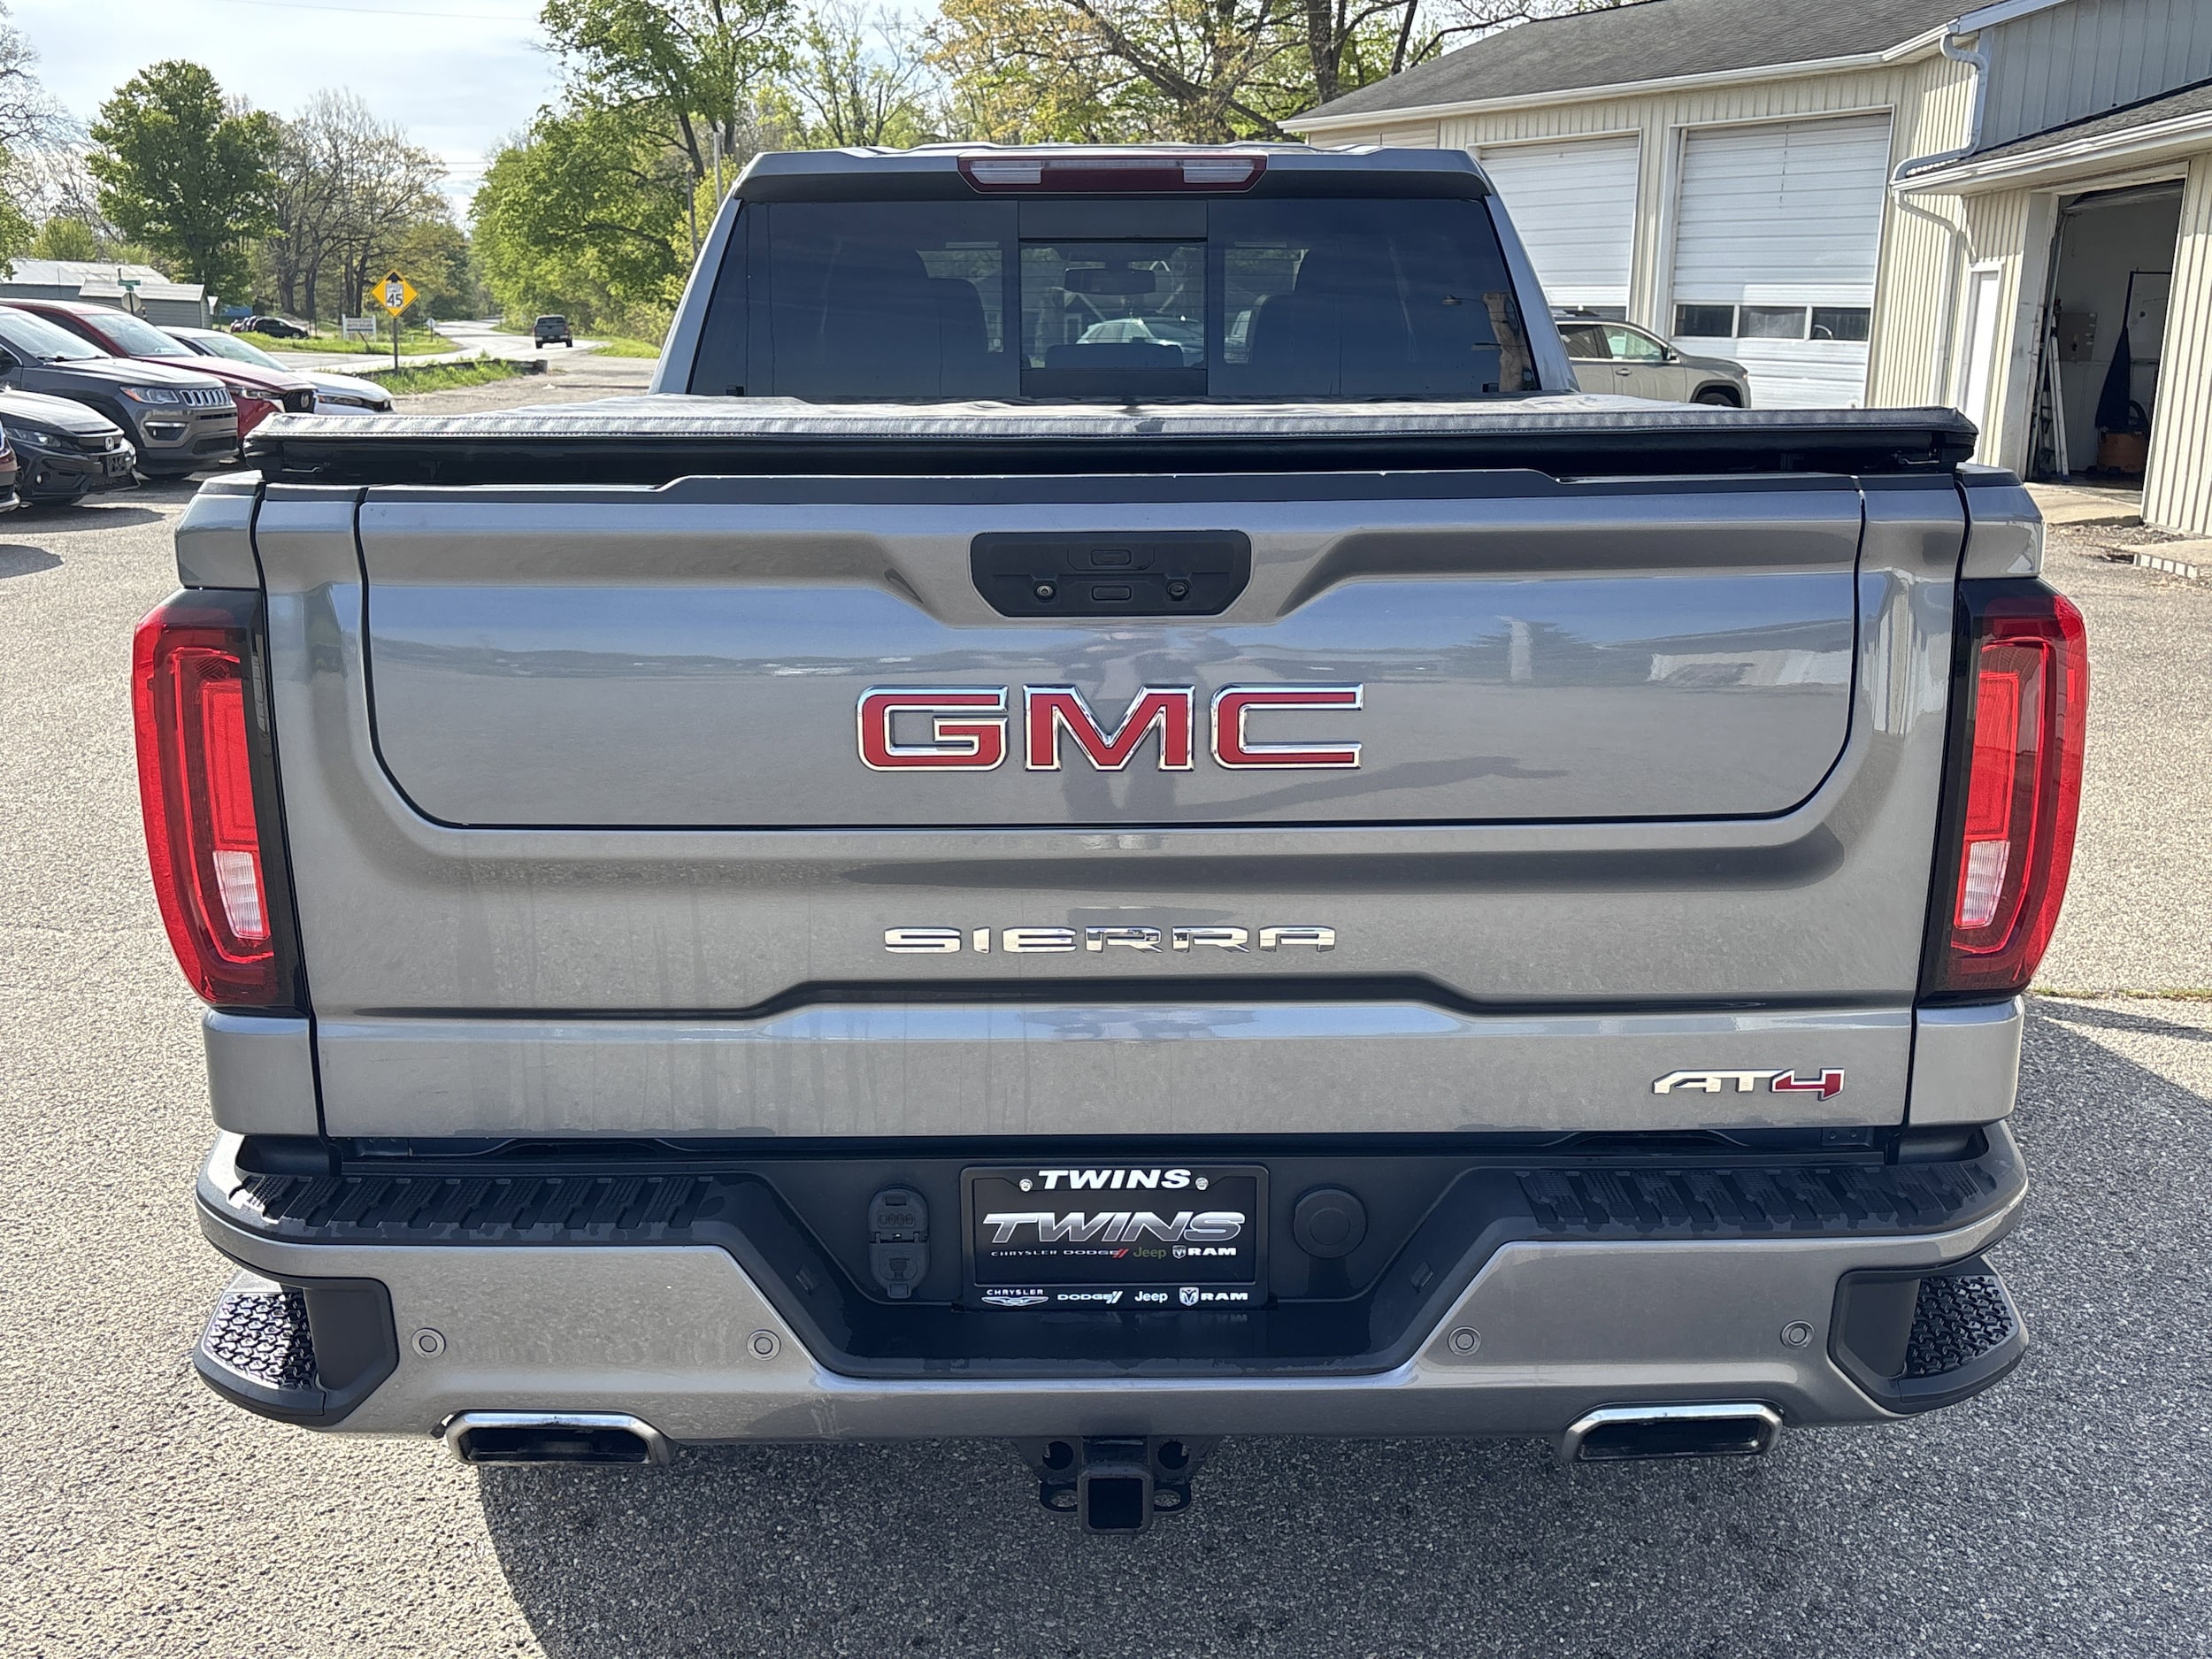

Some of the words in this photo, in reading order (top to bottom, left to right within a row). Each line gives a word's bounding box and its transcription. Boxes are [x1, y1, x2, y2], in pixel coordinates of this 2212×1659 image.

[387, 294, 403, 306] 45
[856, 684, 1363, 772] GMC
[885, 926, 1335, 953] SIERRA
[1652, 1068, 1845, 1101] AT4
[1038, 1169, 1191, 1189] TWINS
[982, 1211, 1245, 1243] TWINS
[1133, 1247, 1167, 1259] Jeep
[1187, 1247, 1237, 1256] RAM
[1057, 1293, 1113, 1302] DODGE
[1134, 1290, 1168, 1303] Jeep
[1201, 1292, 1248, 1302] RAM
